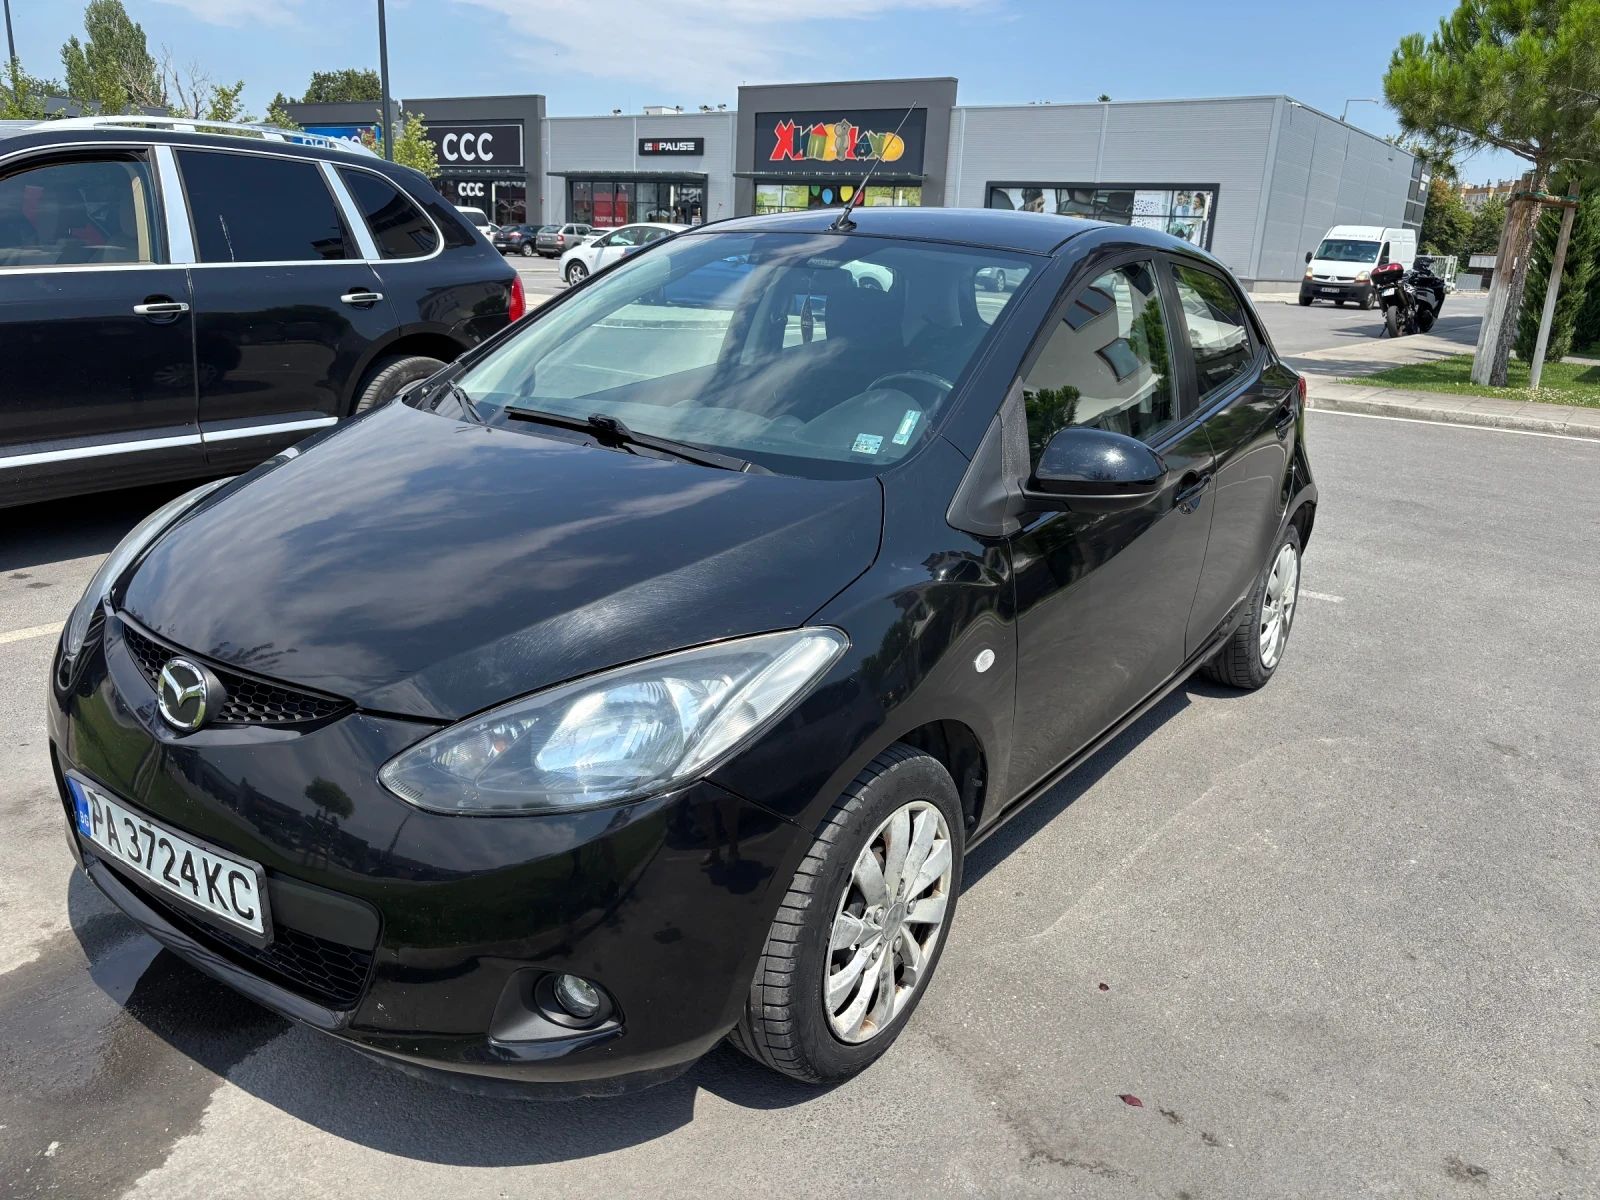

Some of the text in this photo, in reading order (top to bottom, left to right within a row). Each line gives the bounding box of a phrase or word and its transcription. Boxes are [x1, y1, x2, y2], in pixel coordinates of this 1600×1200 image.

[442, 132, 494, 161] CCC
[659, 142, 695, 151] PAUSE
[458, 182, 484, 197] CCC
[80, 811, 90, 828] BG
